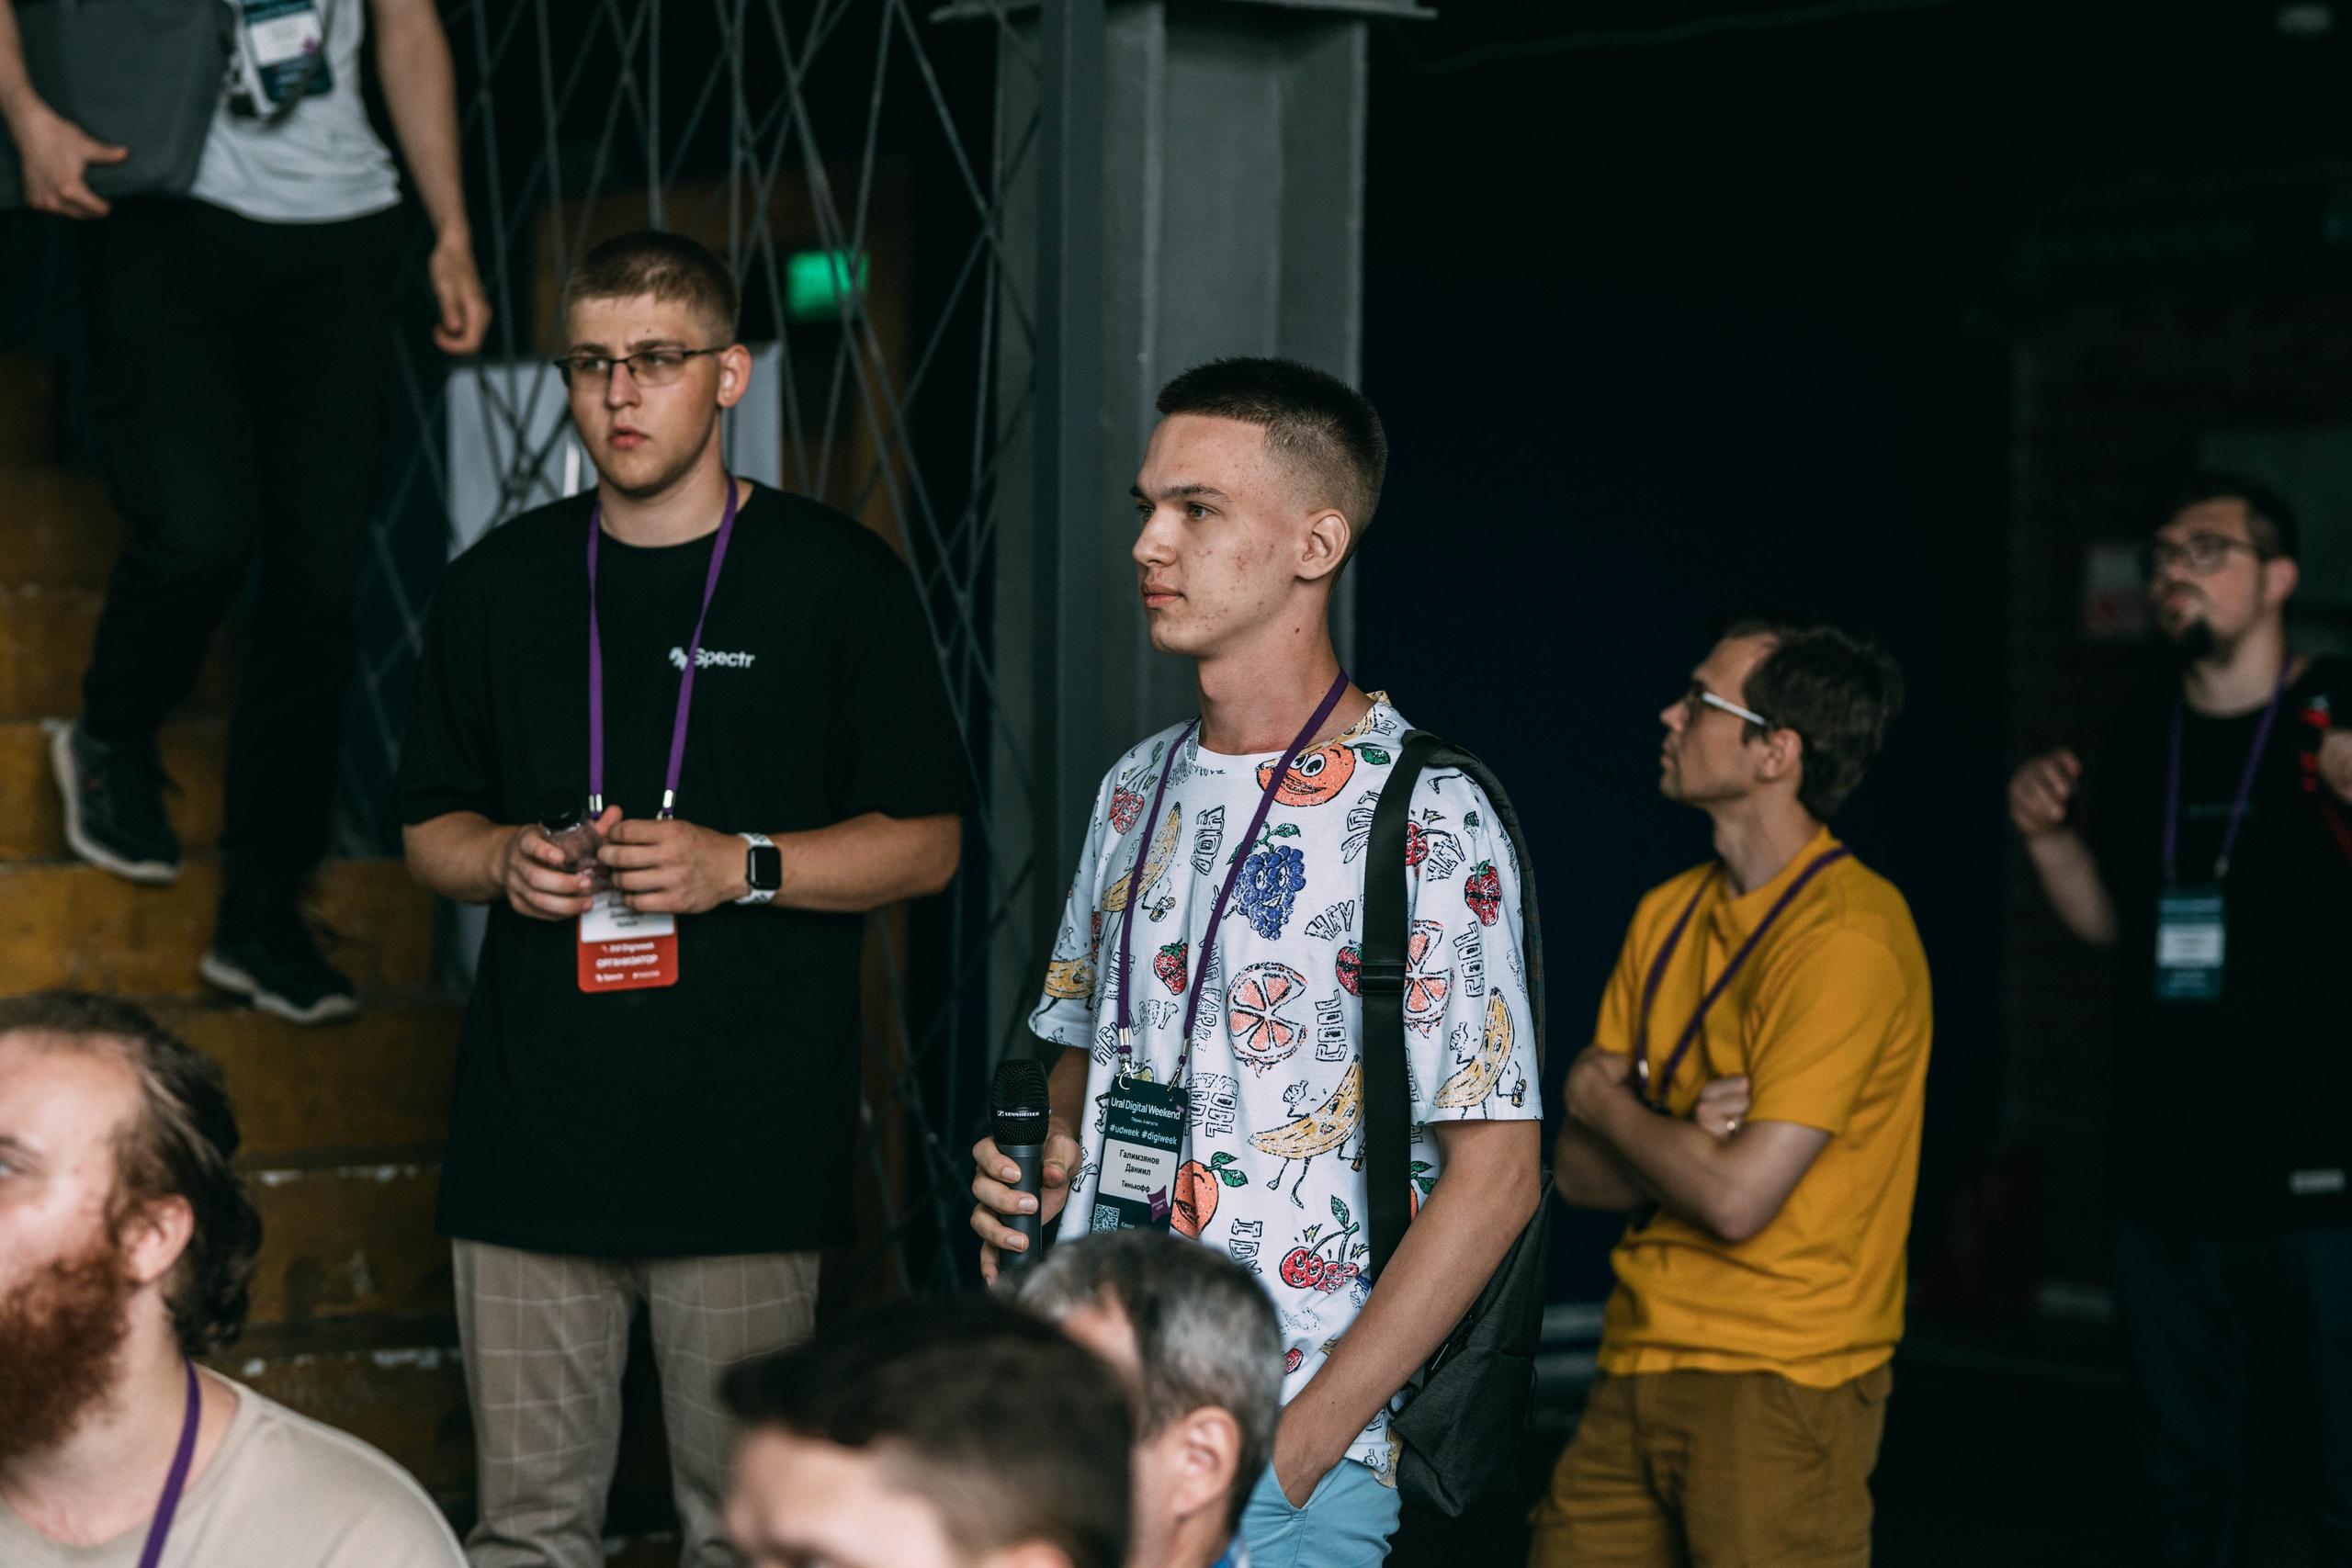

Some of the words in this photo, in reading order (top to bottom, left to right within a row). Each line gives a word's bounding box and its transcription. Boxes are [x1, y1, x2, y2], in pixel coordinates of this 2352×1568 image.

[694, 647, 756, 670] Spectr
[1304, 899, 1355, 942] HEY
[1453, 920, 1486, 998] COOL
[1315, 988, 1349, 1063] COOL
[1110, 1097, 1125, 1109] Ural
[1125, 1100, 1148, 1114] Digital
[1148, 1104, 1182, 1120] Weekend
[1109, 1123, 1140, 1137] #udweek
[1141, 1130, 1178, 1145] #digiweek
[1119, 1149, 1160, 1165] Галимзянов
[1125, 1163, 1151, 1176] Даниил
[1121, 1179, 1151, 1193] Тинькофф
